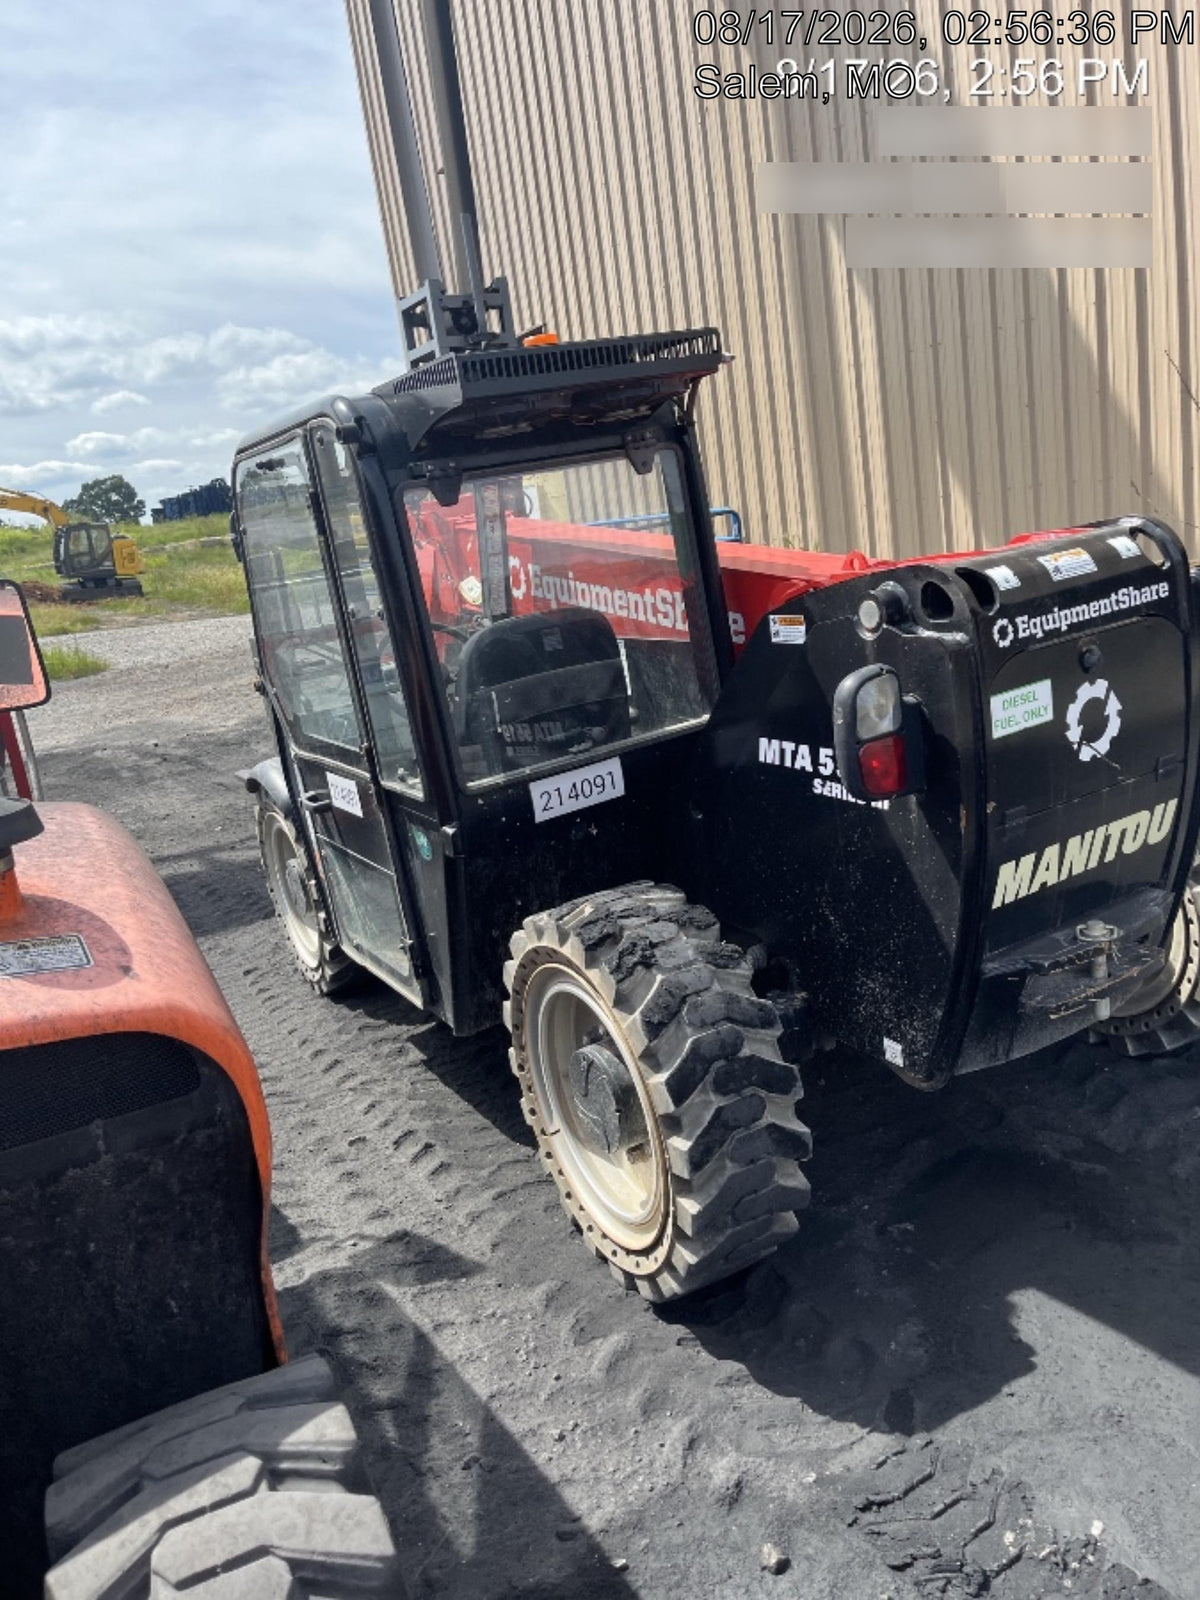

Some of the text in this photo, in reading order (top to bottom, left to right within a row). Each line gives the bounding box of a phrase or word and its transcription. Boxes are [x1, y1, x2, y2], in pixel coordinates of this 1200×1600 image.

[1015, 581, 1169, 638] EquipmentShare
[994, 705, 1049, 732] FUEL ONLY
[1003, 690, 1039, 710] DIESEL
[758, 737, 813, 772] MTA
[540, 770, 616, 812] 214091
[992, 798, 1178, 909] MANITOU
